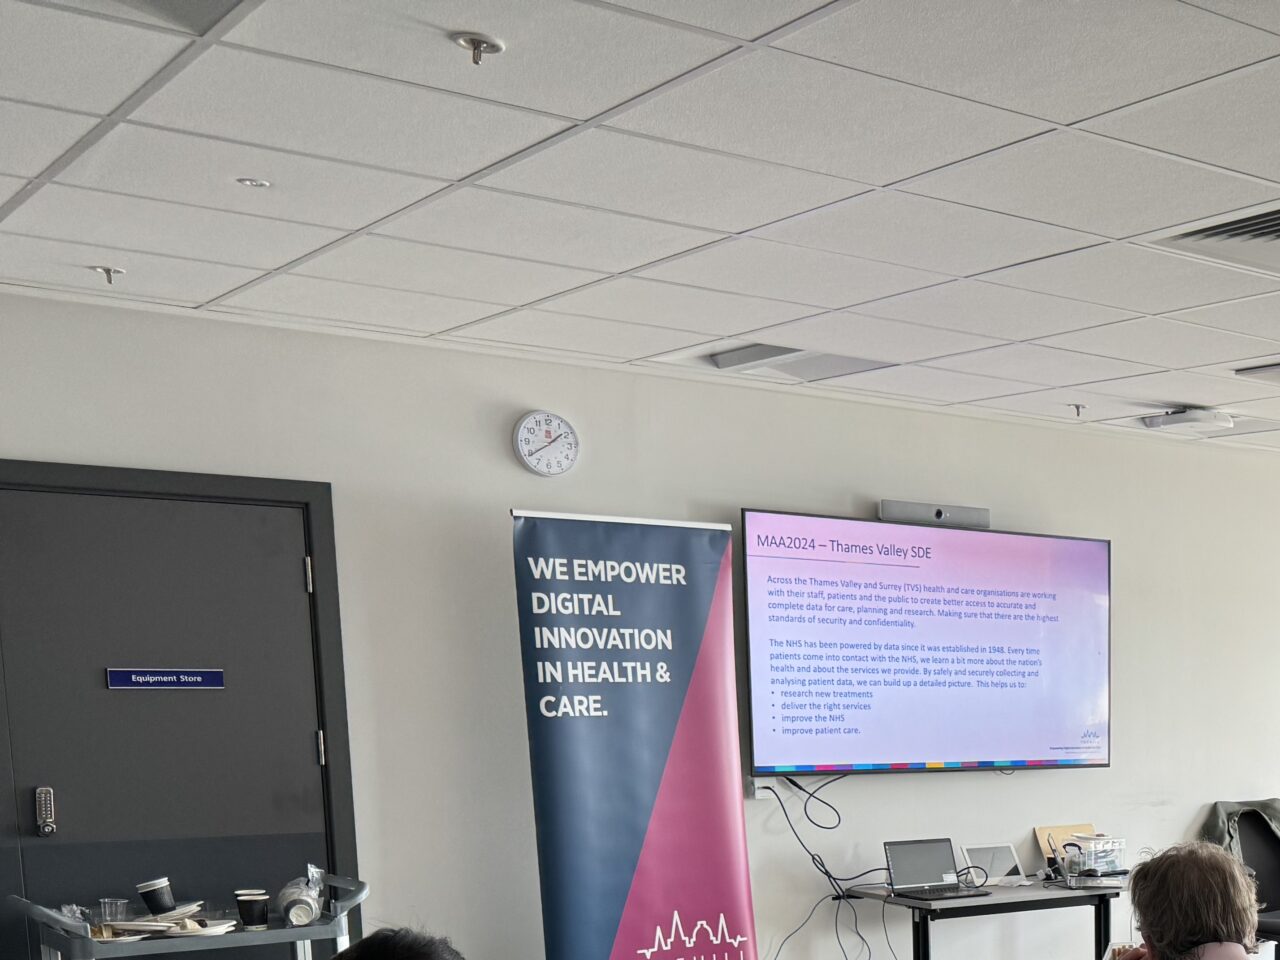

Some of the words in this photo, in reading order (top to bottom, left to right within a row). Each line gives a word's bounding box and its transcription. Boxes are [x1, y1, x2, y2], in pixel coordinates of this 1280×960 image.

[757, 534, 815, 550] MAA2024
[829, 539, 873, 554] Thames
[876, 543, 908, 559] Valley
[910, 546, 931, 559] SDE
[528, 558, 568, 580] WE
[574, 560, 686, 585] EMPOWER
[767, 575, 792, 584] Across
[809, 577, 838, 586] Thames
[840, 579, 862, 589] Valley
[863, 581, 877, 589] and
[878, 581, 901, 592] Surrey
[903, 583, 921, 592] (TVS)
[922, 584, 945, 593] health
[976, 588, 1018, 598] organisations
[1032, 591, 1056, 600] working
[767, 588, 784, 596] with
[786, 589, 804, 597] their
[827, 592, 857, 601] patients
[858, 593, 872, 601] and
[887, 594, 909, 604] public
[942, 598, 963, 606] better
[532, 593, 621, 616] DIGITAL
[768, 600, 804, 611] complete
[805, 602, 822, 611] data
[824, 602, 835, 611] for
[856, 605, 888, 615] planning
[889, 606, 902, 614] and
[937, 609, 962, 618] Making
[1036, 614, 1058, 623] highest
[768, 614, 805, 622] standards
[807, 615, 816, 623] of
[817, 617, 846, 626] security
[535, 627, 672, 650] INNOVATION
[769, 638, 783, 647] The
[818, 640, 838, 648] been
[839, 641, 872, 650] powered
[873, 642, 882, 650] by
[941, 644, 979, 653] established
[1007, 646, 1024, 655] Every
[769, 652, 801, 660] patients
[901, 655, 918, 663] NHS,
[538, 662, 561, 683] IN
[568, 662, 651, 682] HEALTH
[656, 662, 670, 682] &
[770, 664, 794, 672] health
[893, 667, 921, 675] provide.
[922, 667, 931, 676] By
[933, 667, 952, 676] safely
[967, 668, 994, 677] securely
[995, 669, 1026, 678] collecting
[770, 677, 806, 686] analysing
[807, 678, 834, 686] patient
[539, 696, 608, 717] CARE.
[823, 702, 840, 711] right
